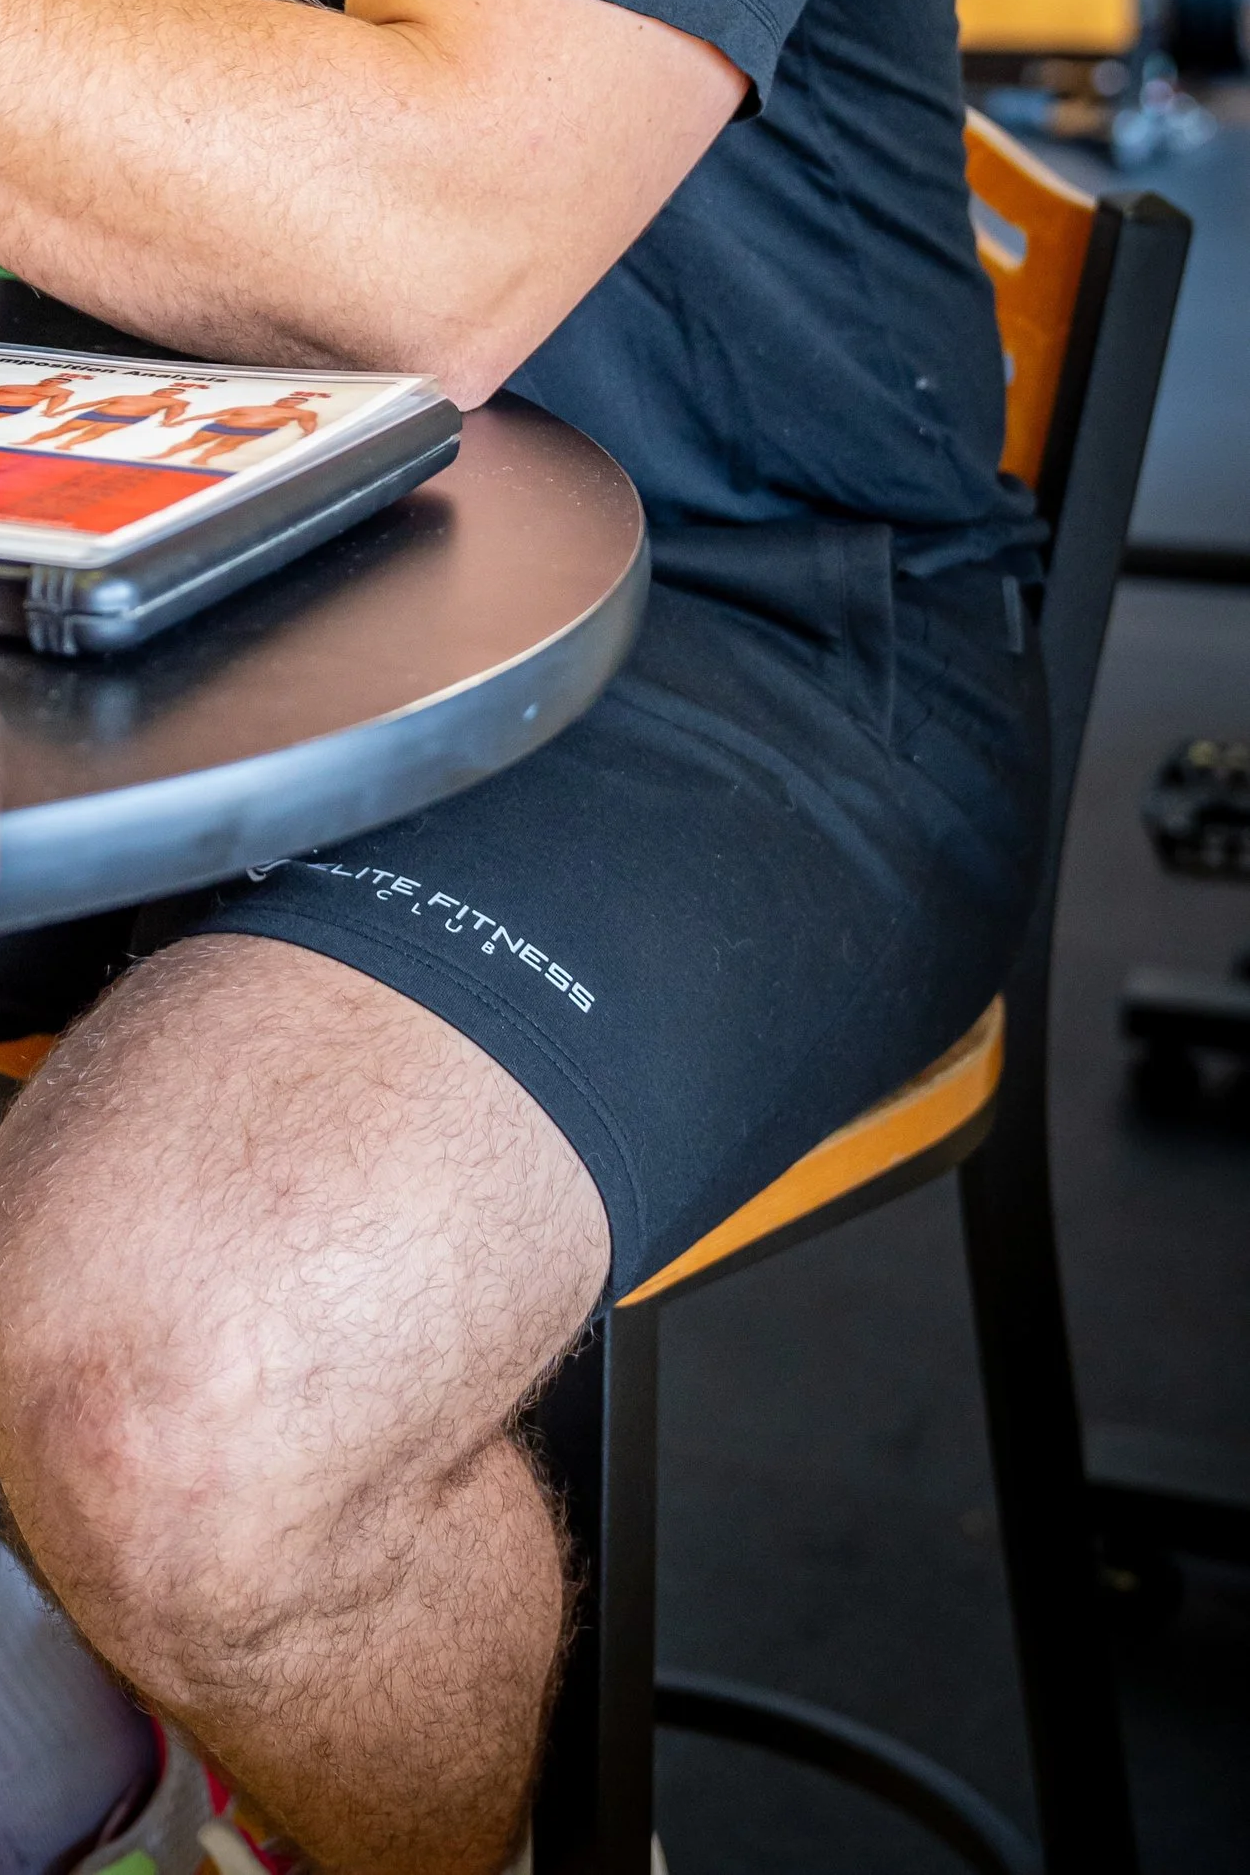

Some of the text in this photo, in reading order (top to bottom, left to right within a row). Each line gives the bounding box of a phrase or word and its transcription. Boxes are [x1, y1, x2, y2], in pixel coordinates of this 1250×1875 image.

[122, 370, 229, 384] Analysis
[306, 862, 596, 1014] ELITE FITNESS
